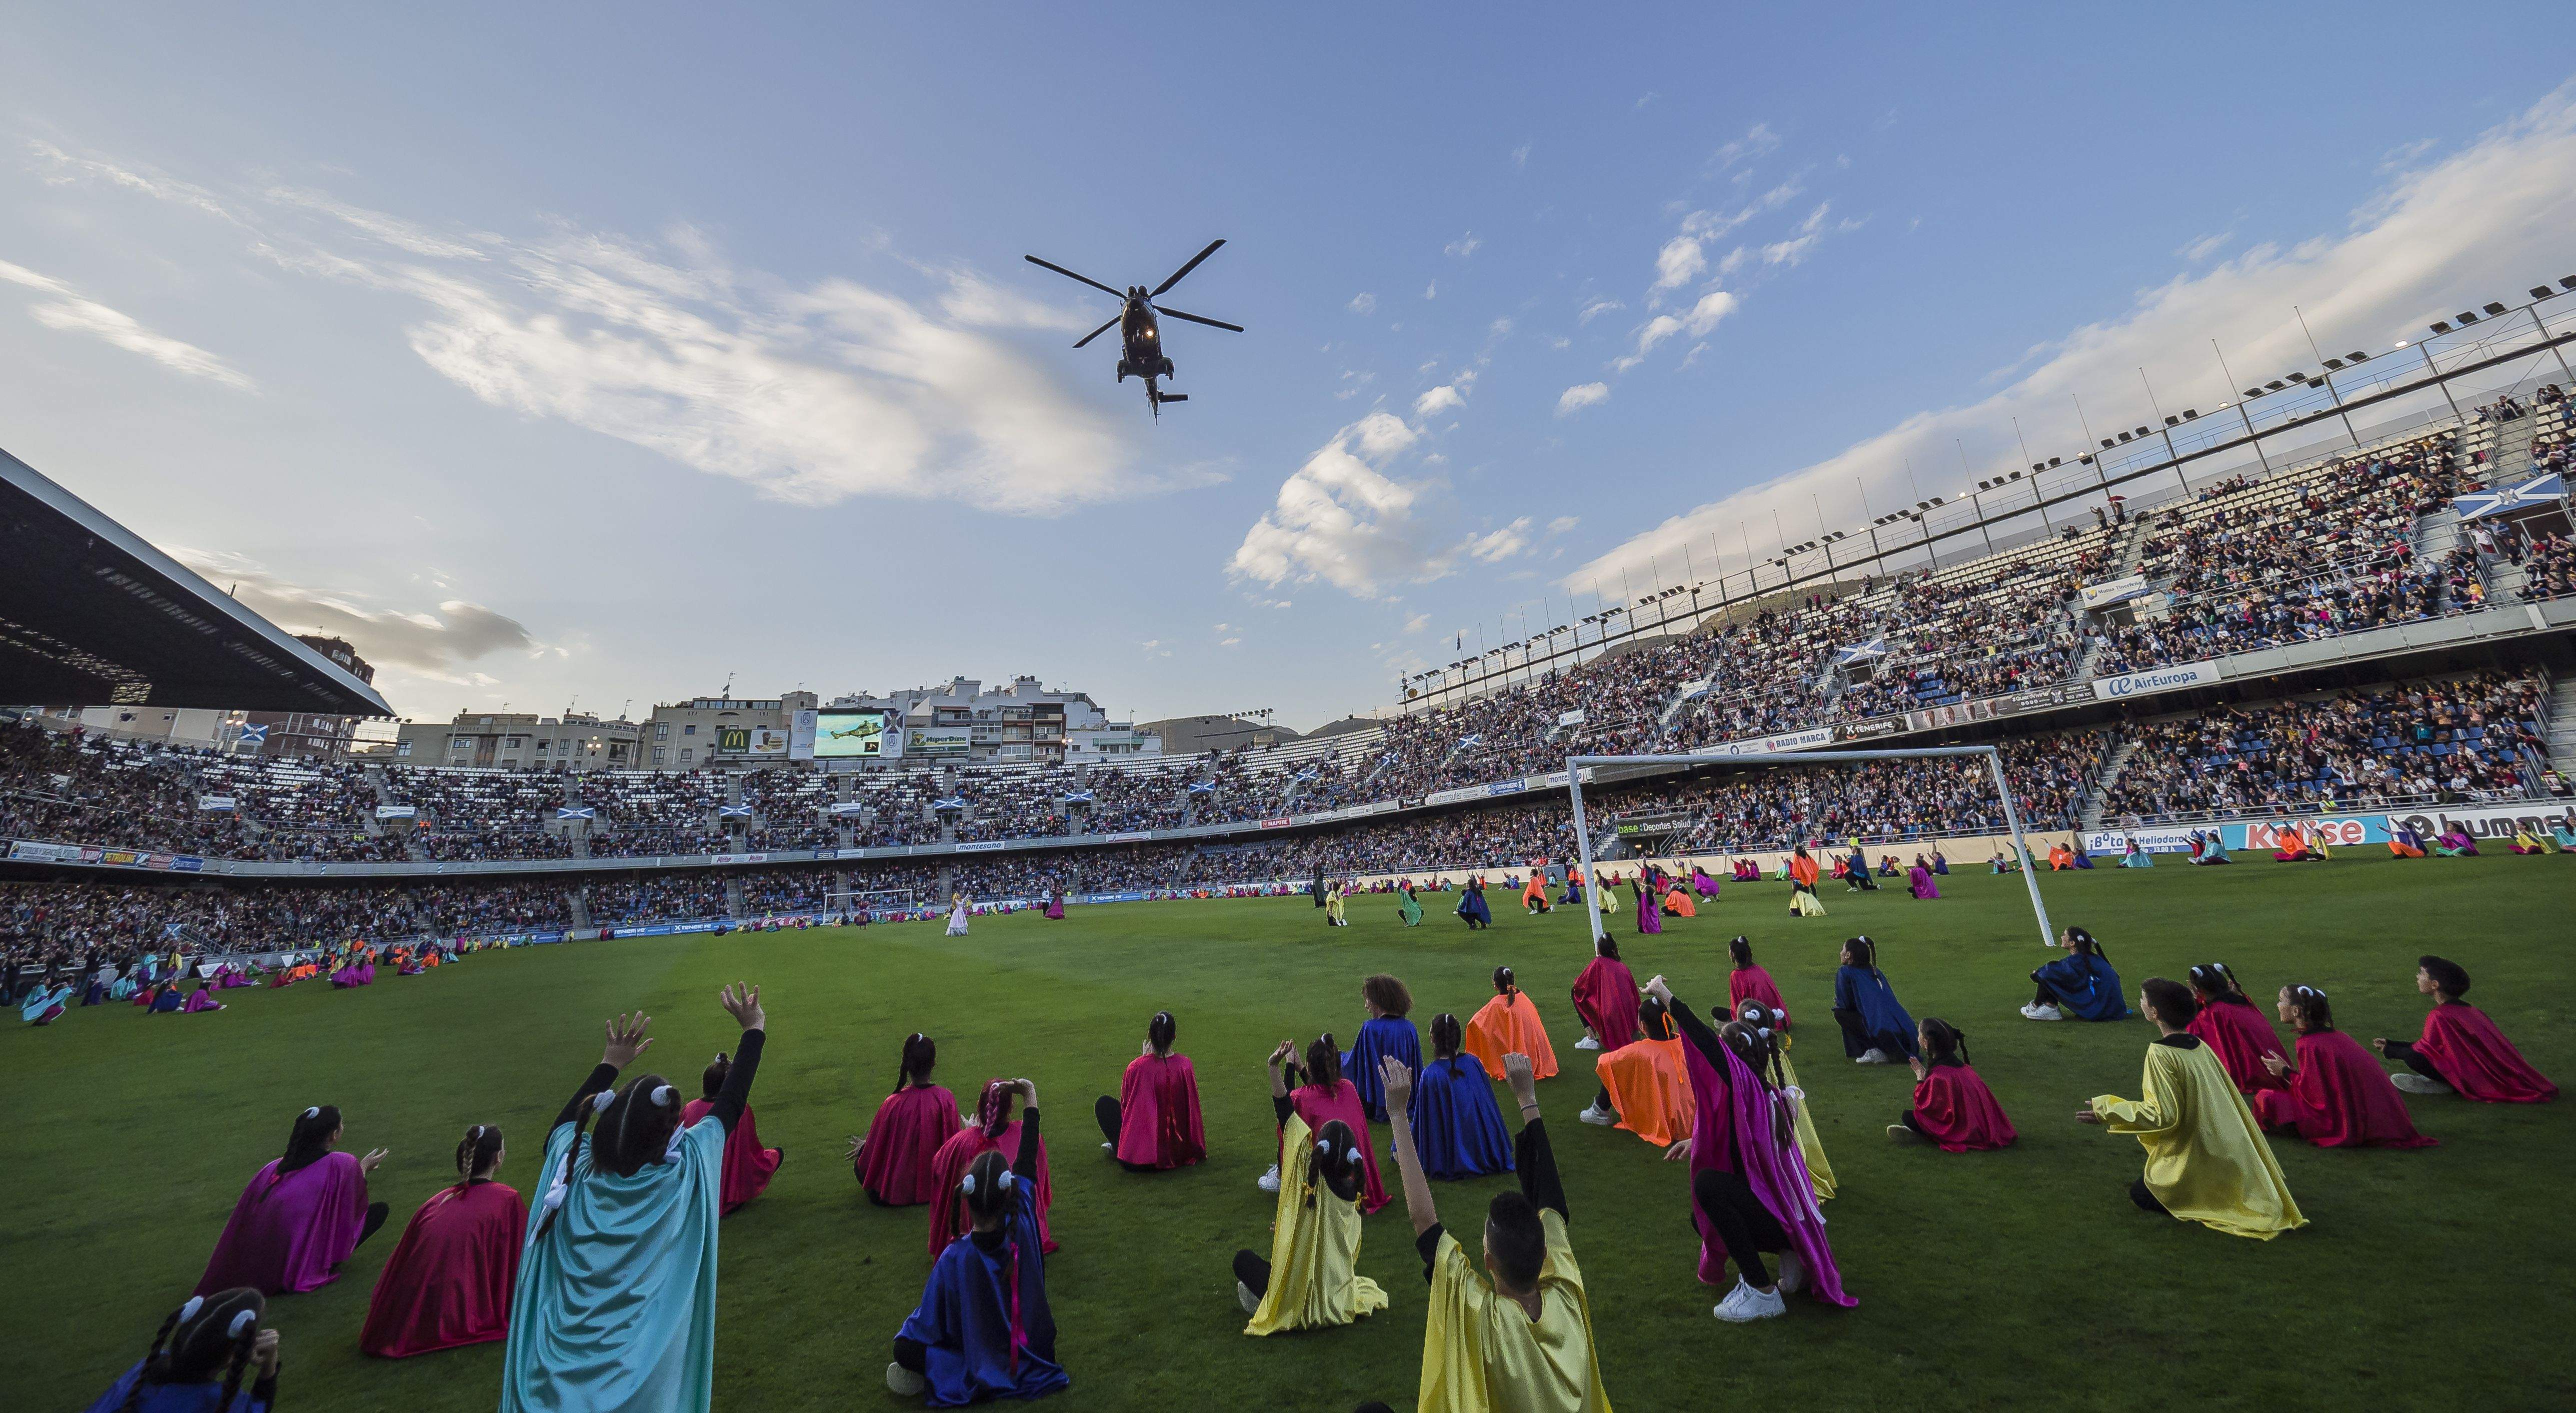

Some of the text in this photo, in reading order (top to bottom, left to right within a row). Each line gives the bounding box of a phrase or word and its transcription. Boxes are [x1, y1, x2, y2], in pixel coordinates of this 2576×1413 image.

[2134, 672, 2197, 689] AirEuropa
[1855, 721, 1893, 733] TENERIFE
[1776, 738, 1797, 748] RADIO
[1799, 732, 1826, 744] MARCA
[1434, 791, 1461, 803] autoinsular
[1643, 822, 1671, 832] Deportes
[1672, 820, 1691, 828] Salud
